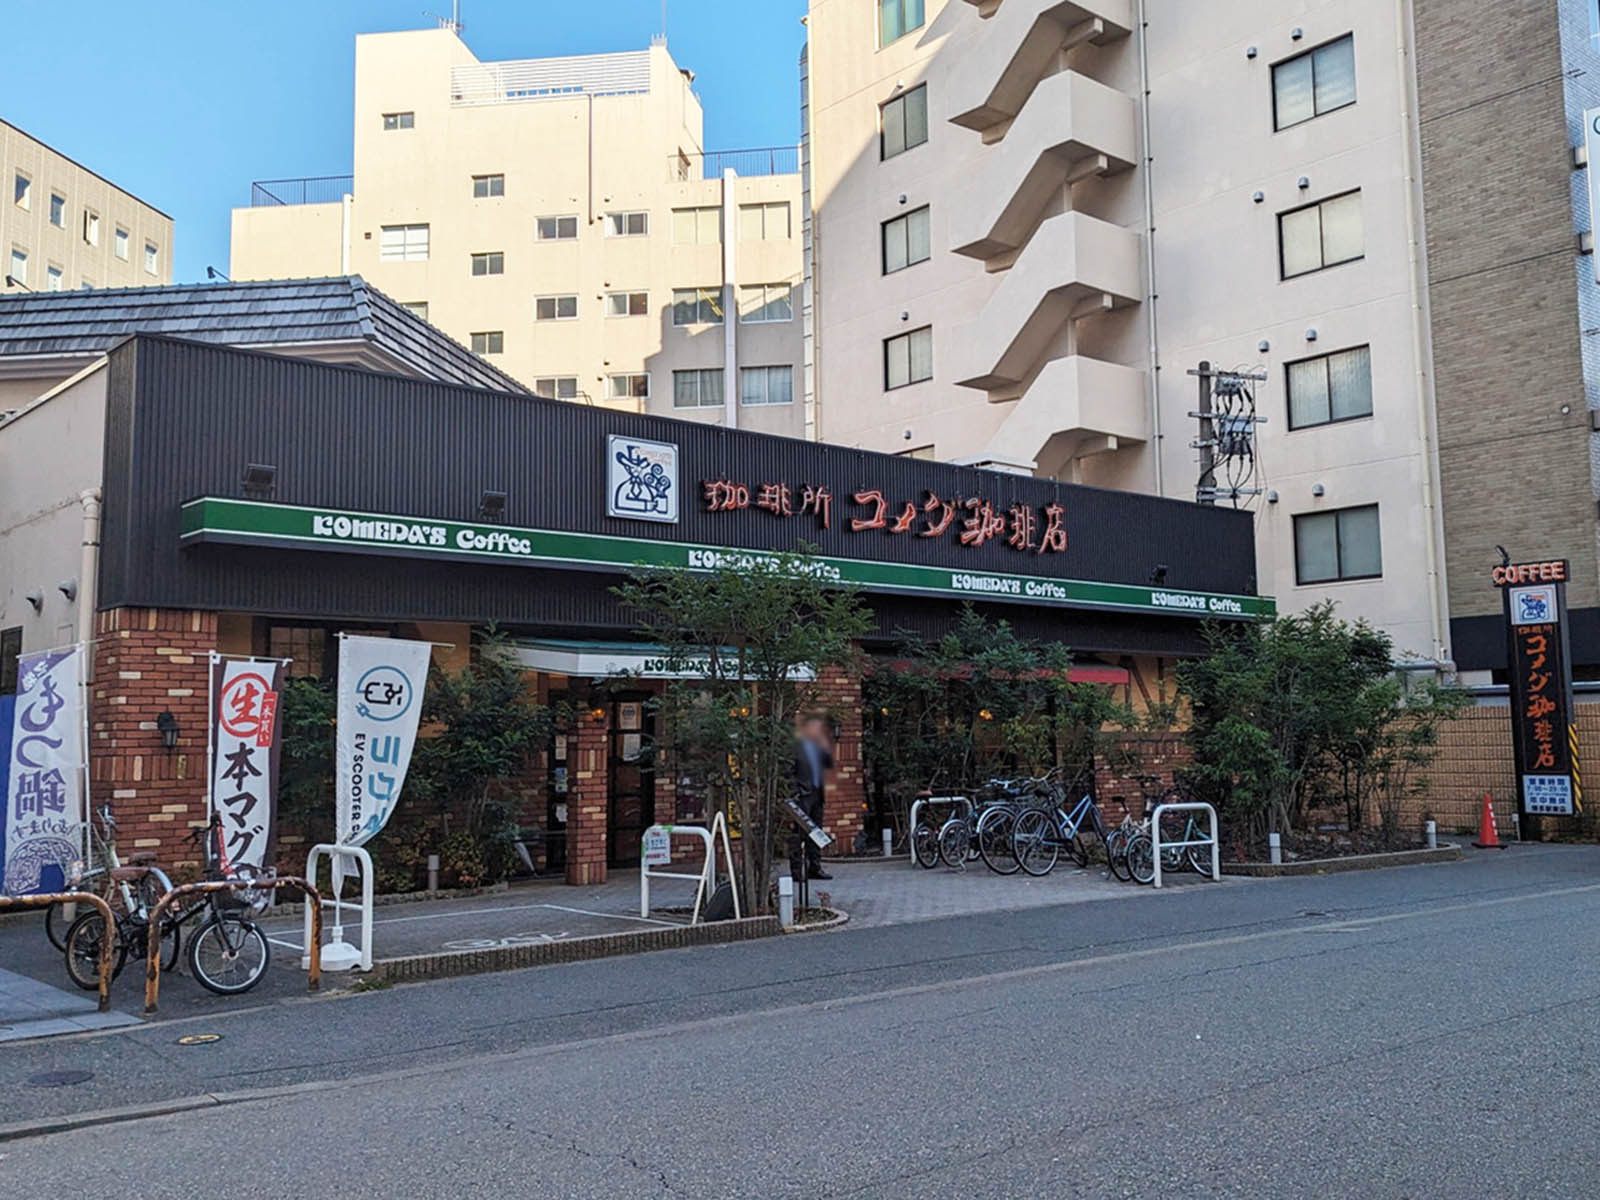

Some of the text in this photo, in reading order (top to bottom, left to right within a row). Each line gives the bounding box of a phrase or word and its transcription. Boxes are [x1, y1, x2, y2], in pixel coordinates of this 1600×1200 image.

[313, 514, 532, 555] KOMEDA'S Coffee
[1492, 560, 1565, 585] COFFEE
[951, 573, 1066, 599] KOMEDA'S Coffee
[1151, 591, 1242, 613] KOMEDA'S Coffee
[228, 681, 260, 727] 生
[355, 732, 366, 750] EV
[350, 754, 365, 821] SCOOTER
